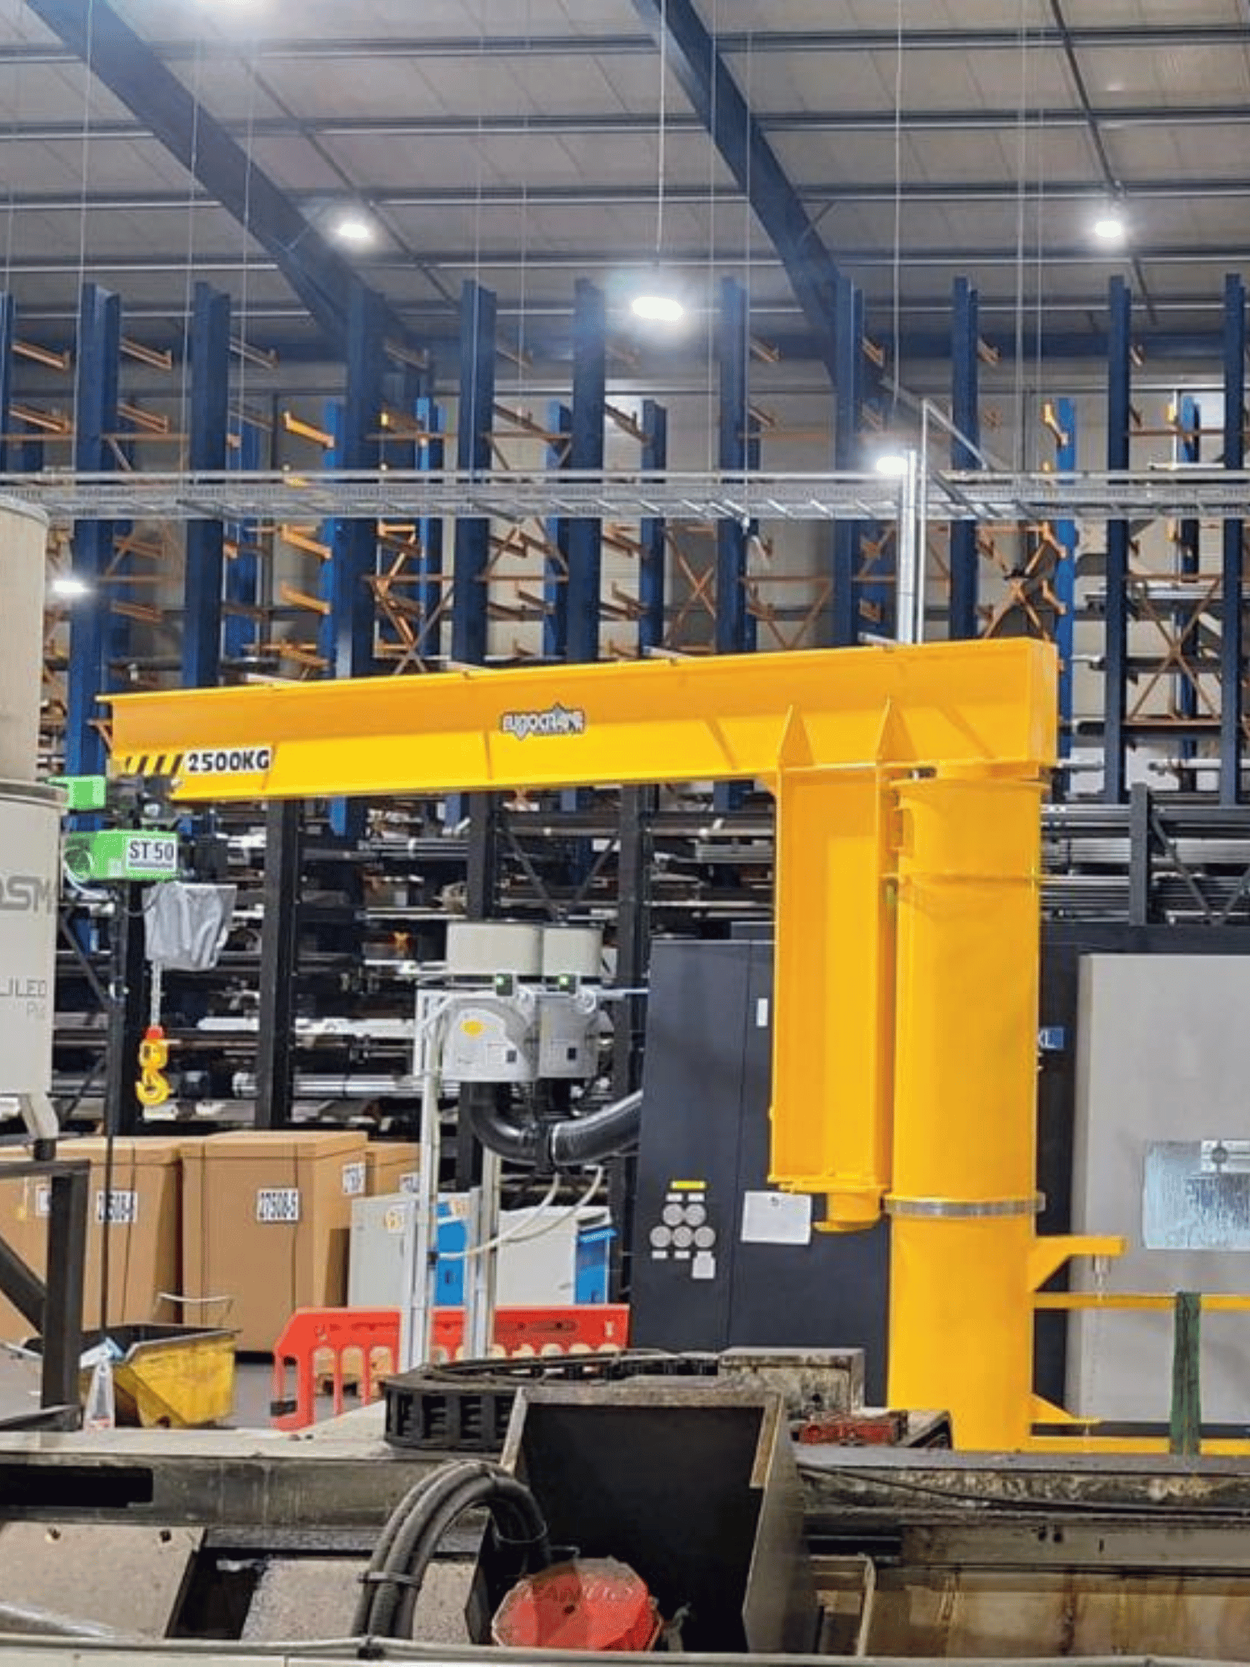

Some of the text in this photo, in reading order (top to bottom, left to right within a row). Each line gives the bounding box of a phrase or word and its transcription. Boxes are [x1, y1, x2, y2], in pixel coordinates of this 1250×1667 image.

[187, 749, 270, 772] 2500KG
[129, 840, 175, 861] ST 50
